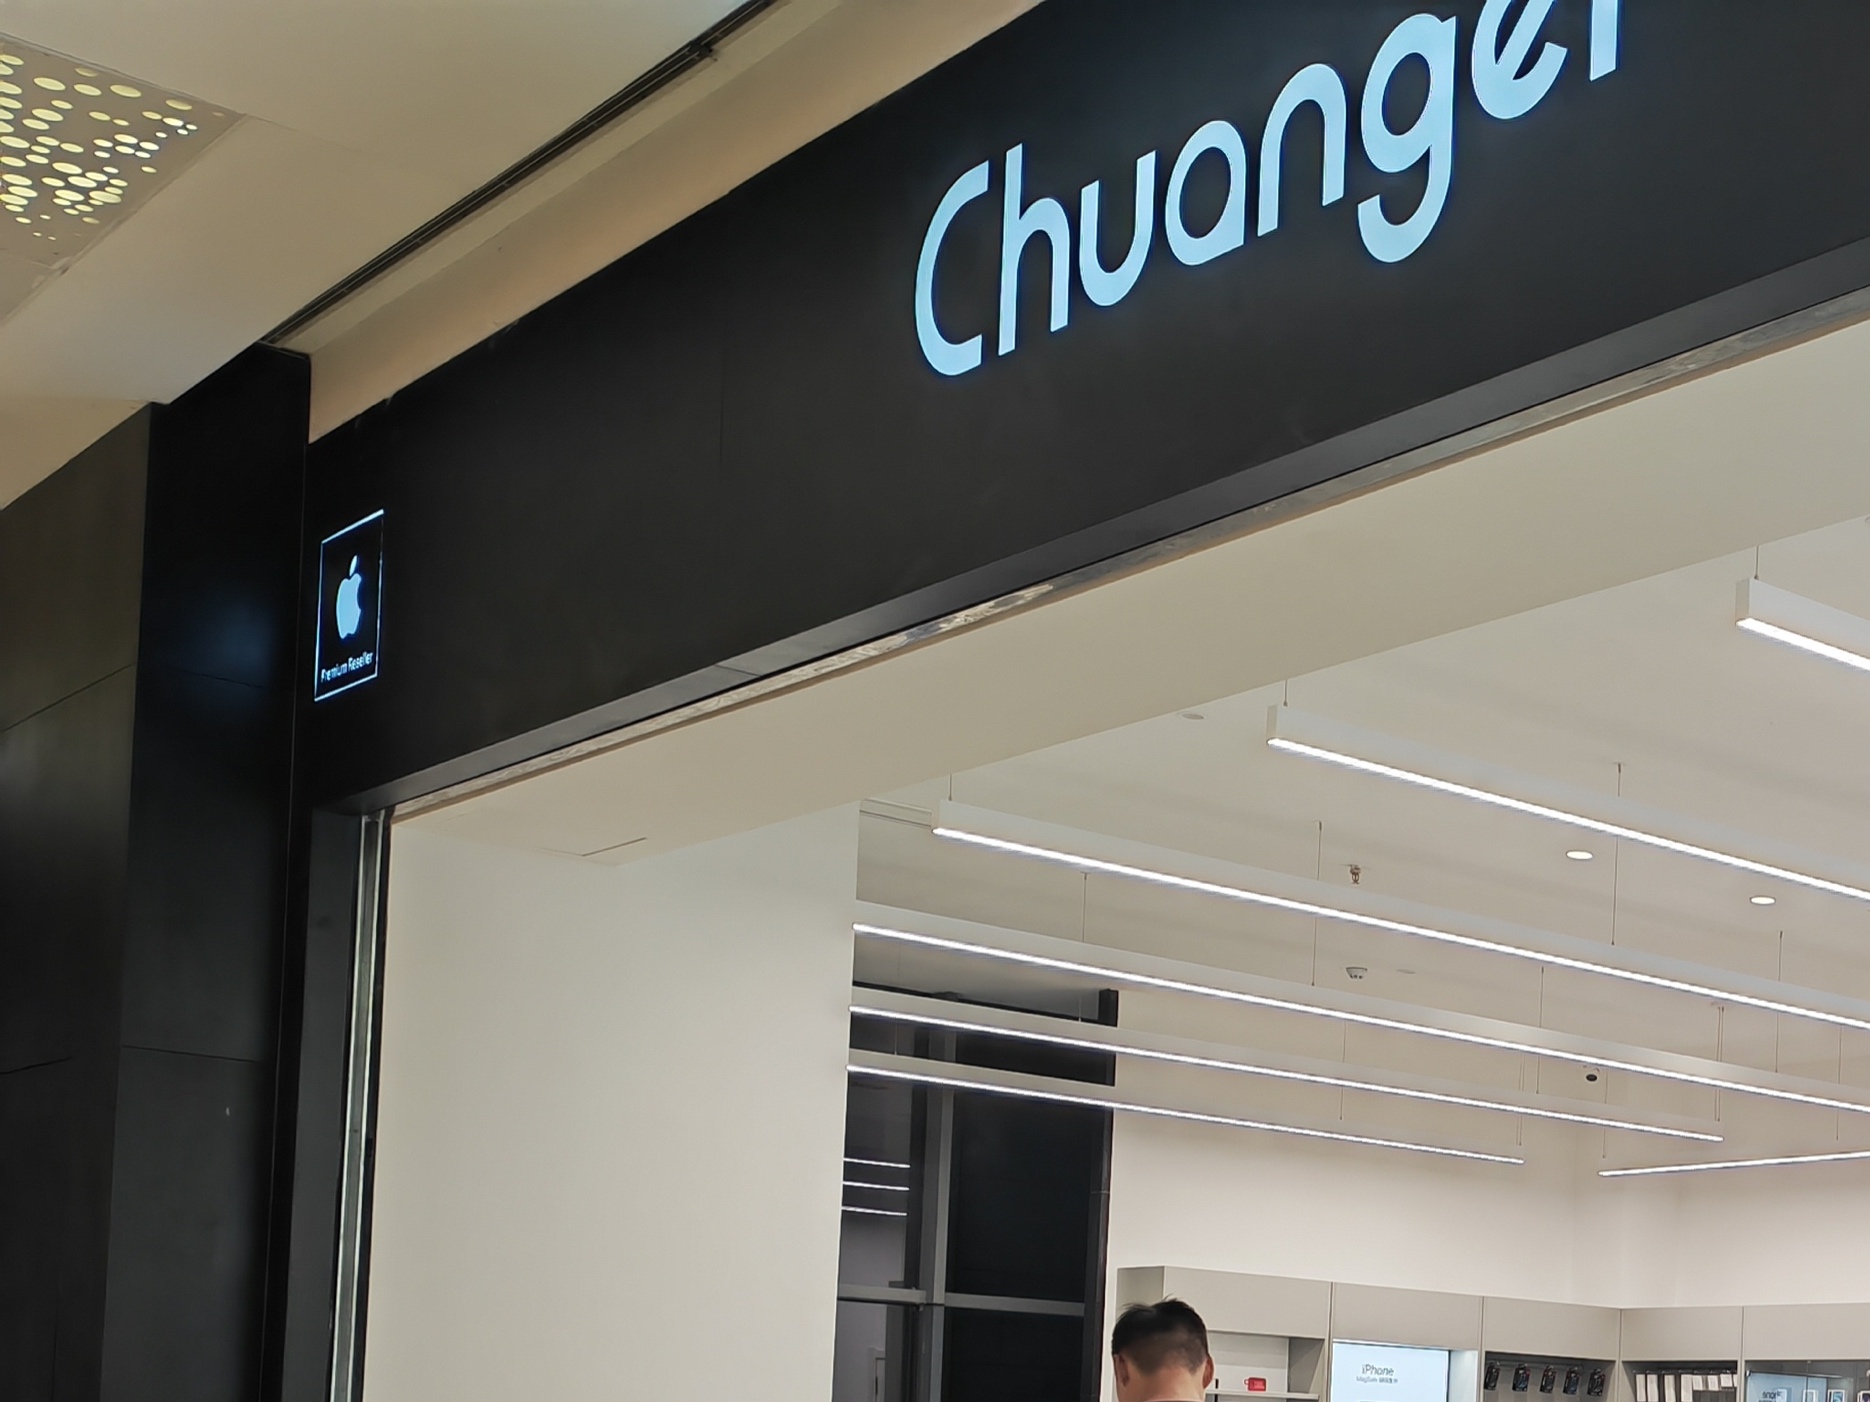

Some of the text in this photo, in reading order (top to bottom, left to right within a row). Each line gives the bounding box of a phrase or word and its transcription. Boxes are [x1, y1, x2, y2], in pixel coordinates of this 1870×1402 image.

[321, 651, 373, 683] Premium Reseller
[1361, 1363, 1394, 1376] iPhone
